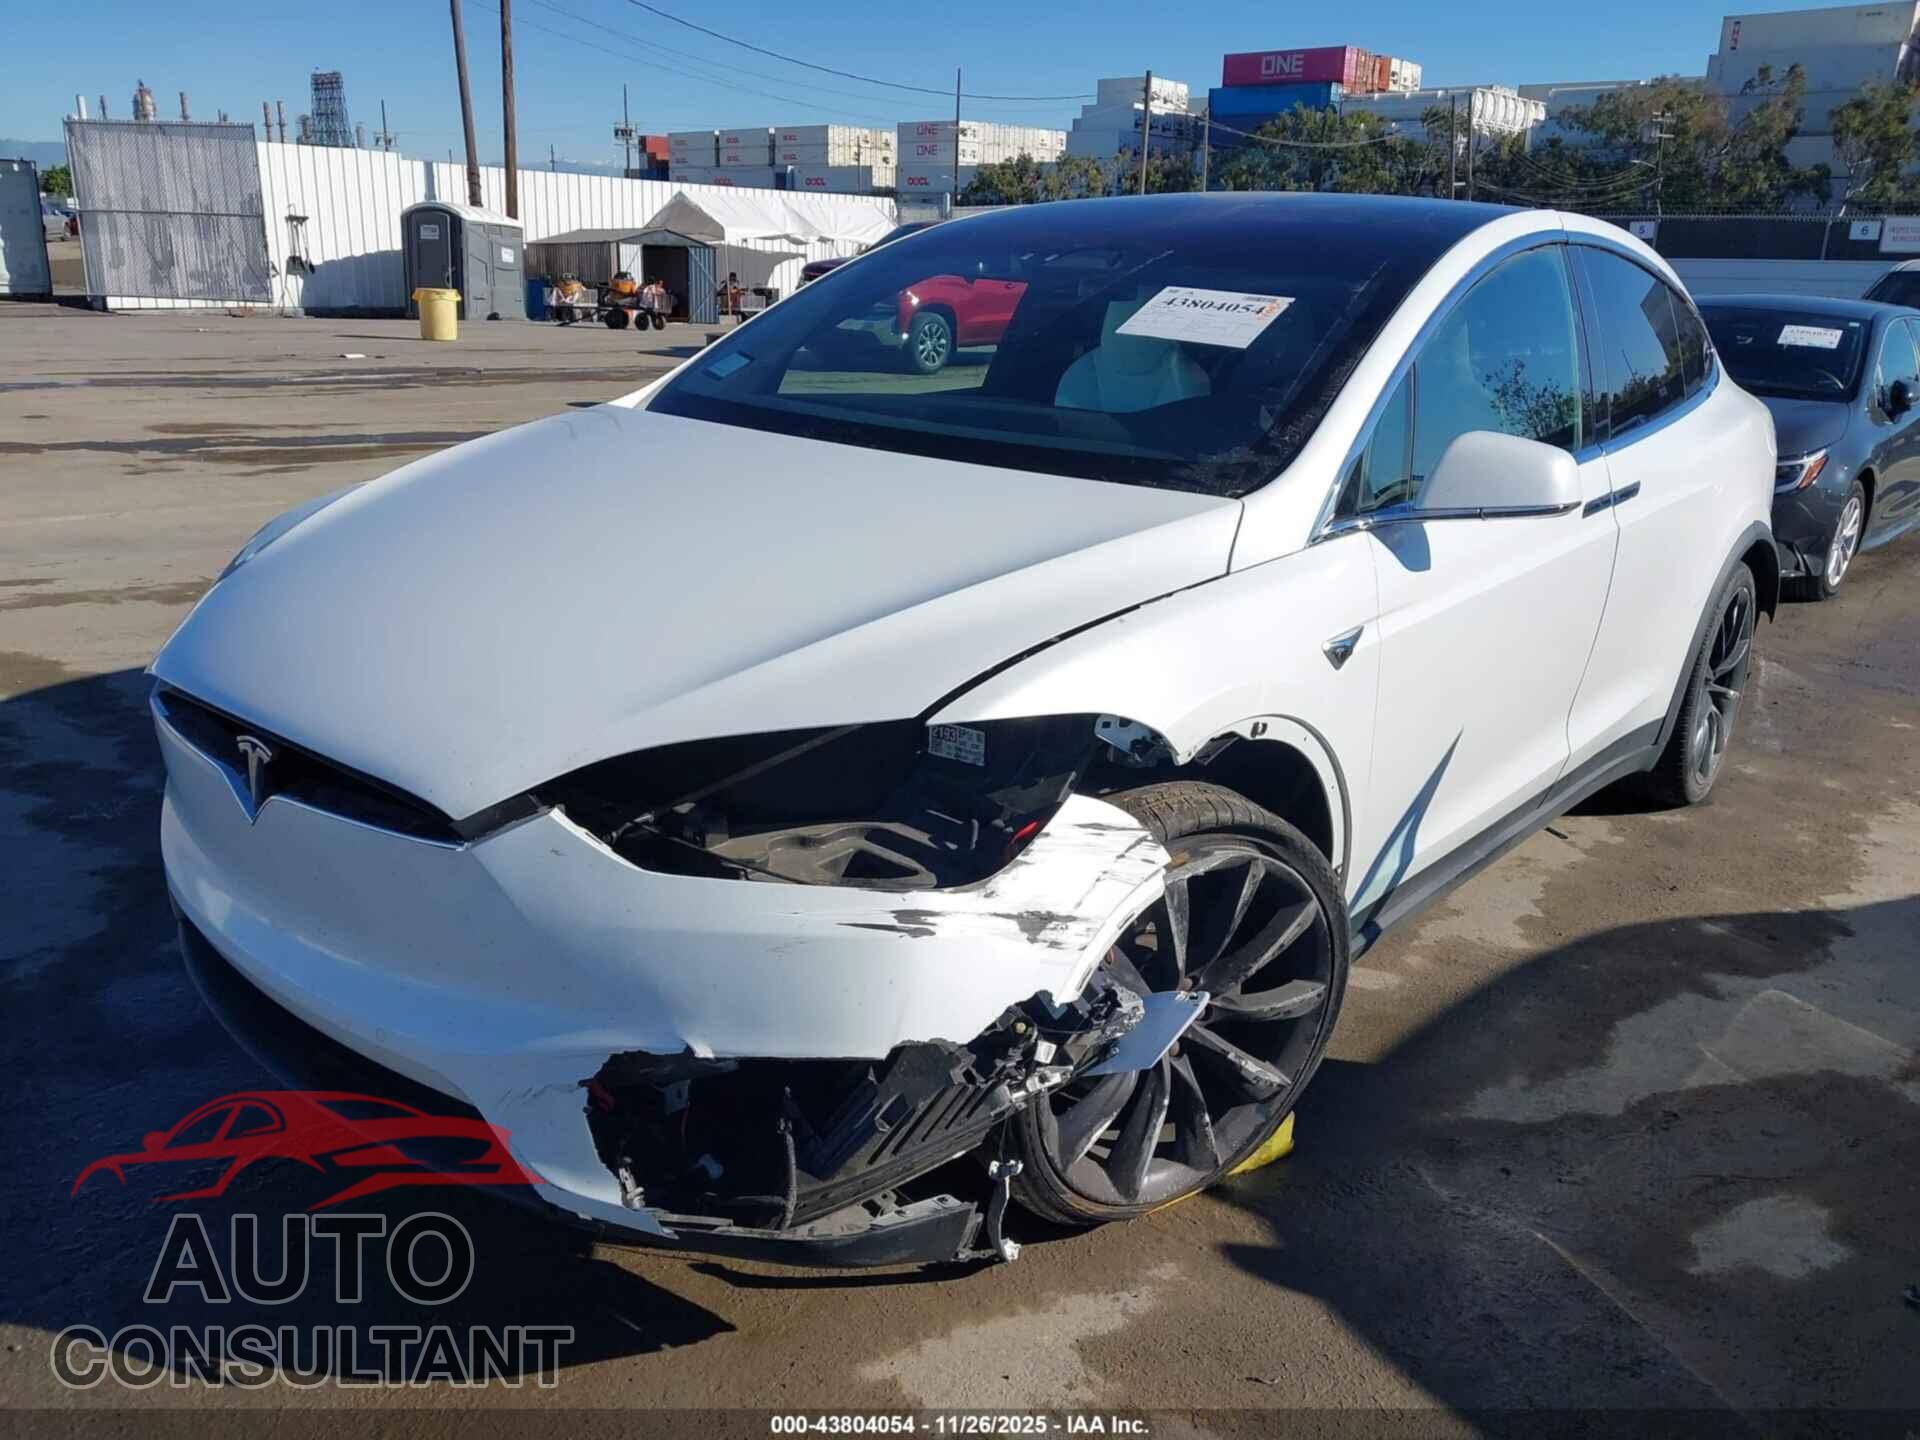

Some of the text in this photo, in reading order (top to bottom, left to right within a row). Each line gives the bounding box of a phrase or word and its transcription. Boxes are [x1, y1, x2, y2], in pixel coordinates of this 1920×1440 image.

[1262, 54, 1304, 74] ONE
[916, 144, 938, 156] ONE
[805, 177, 826, 186] OOCL
[907, 176, 928, 185] OOCL
[1861, 225, 1869, 236] 6
[1163, 297, 1267, 314] 43804054
